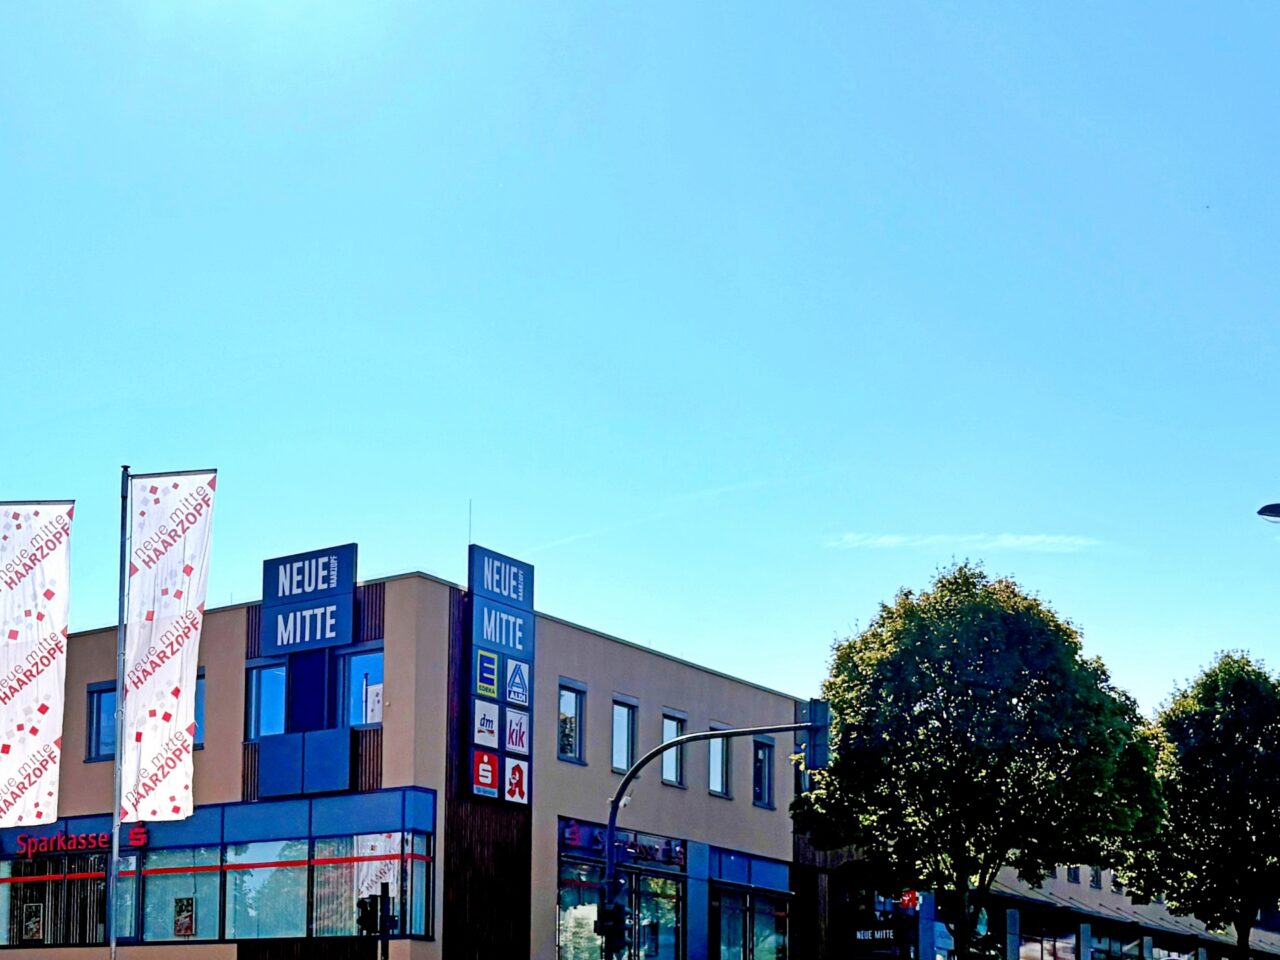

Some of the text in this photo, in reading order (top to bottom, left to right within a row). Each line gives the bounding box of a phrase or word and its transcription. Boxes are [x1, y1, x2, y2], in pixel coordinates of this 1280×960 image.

[30, 515, 65, 548] mitte
[134, 486, 206, 560] neue mitte
[142, 493, 211, 570] HAARZOPF
[4, 522, 70, 591] HAARZOPF
[278, 556, 329, 597] NEUE
[483, 556, 518, 600] NEUE
[127, 610, 195, 681] neue mitte
[277, 604, 337, 646] MITTE
[483, 607, 523, 650] MITTE
[25, 632, 59, 665] mitte
[131, 617, 200, 690] HAARZOPF
[480, 713, 494, 729] dm
[18, 743, 52, 776] mitte
[125, 768, 150, 803] nee
[16, 832, 109, 858] Sparkasse
[856, 929, 894, 939] NEUE MITTE
